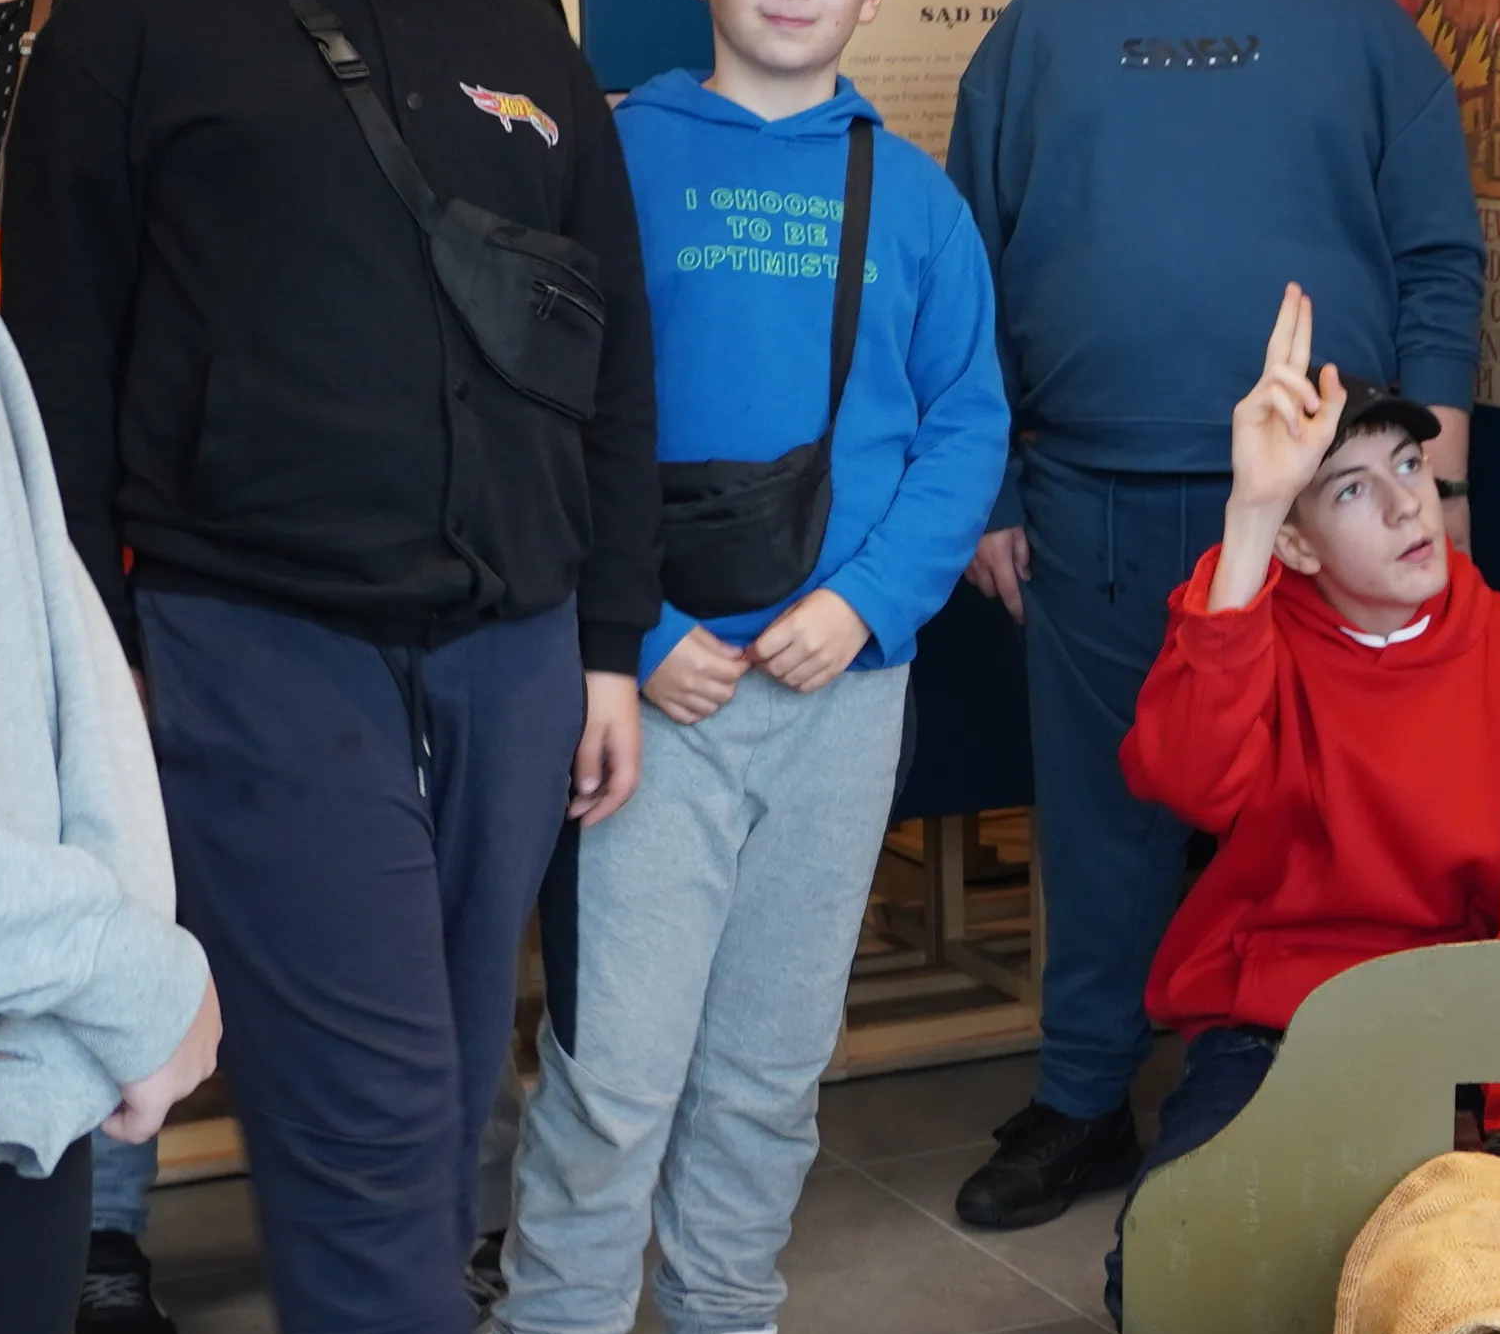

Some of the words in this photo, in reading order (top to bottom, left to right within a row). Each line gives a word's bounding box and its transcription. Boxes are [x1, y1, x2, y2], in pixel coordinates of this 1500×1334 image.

[919, 7, 970, 29] SĄD
[685, 187, 697, 211] I
[710, 187, 845, 224] CHOOSE
[726, 215, 772, 242] TO
[784, 221, 828, 247] BE
